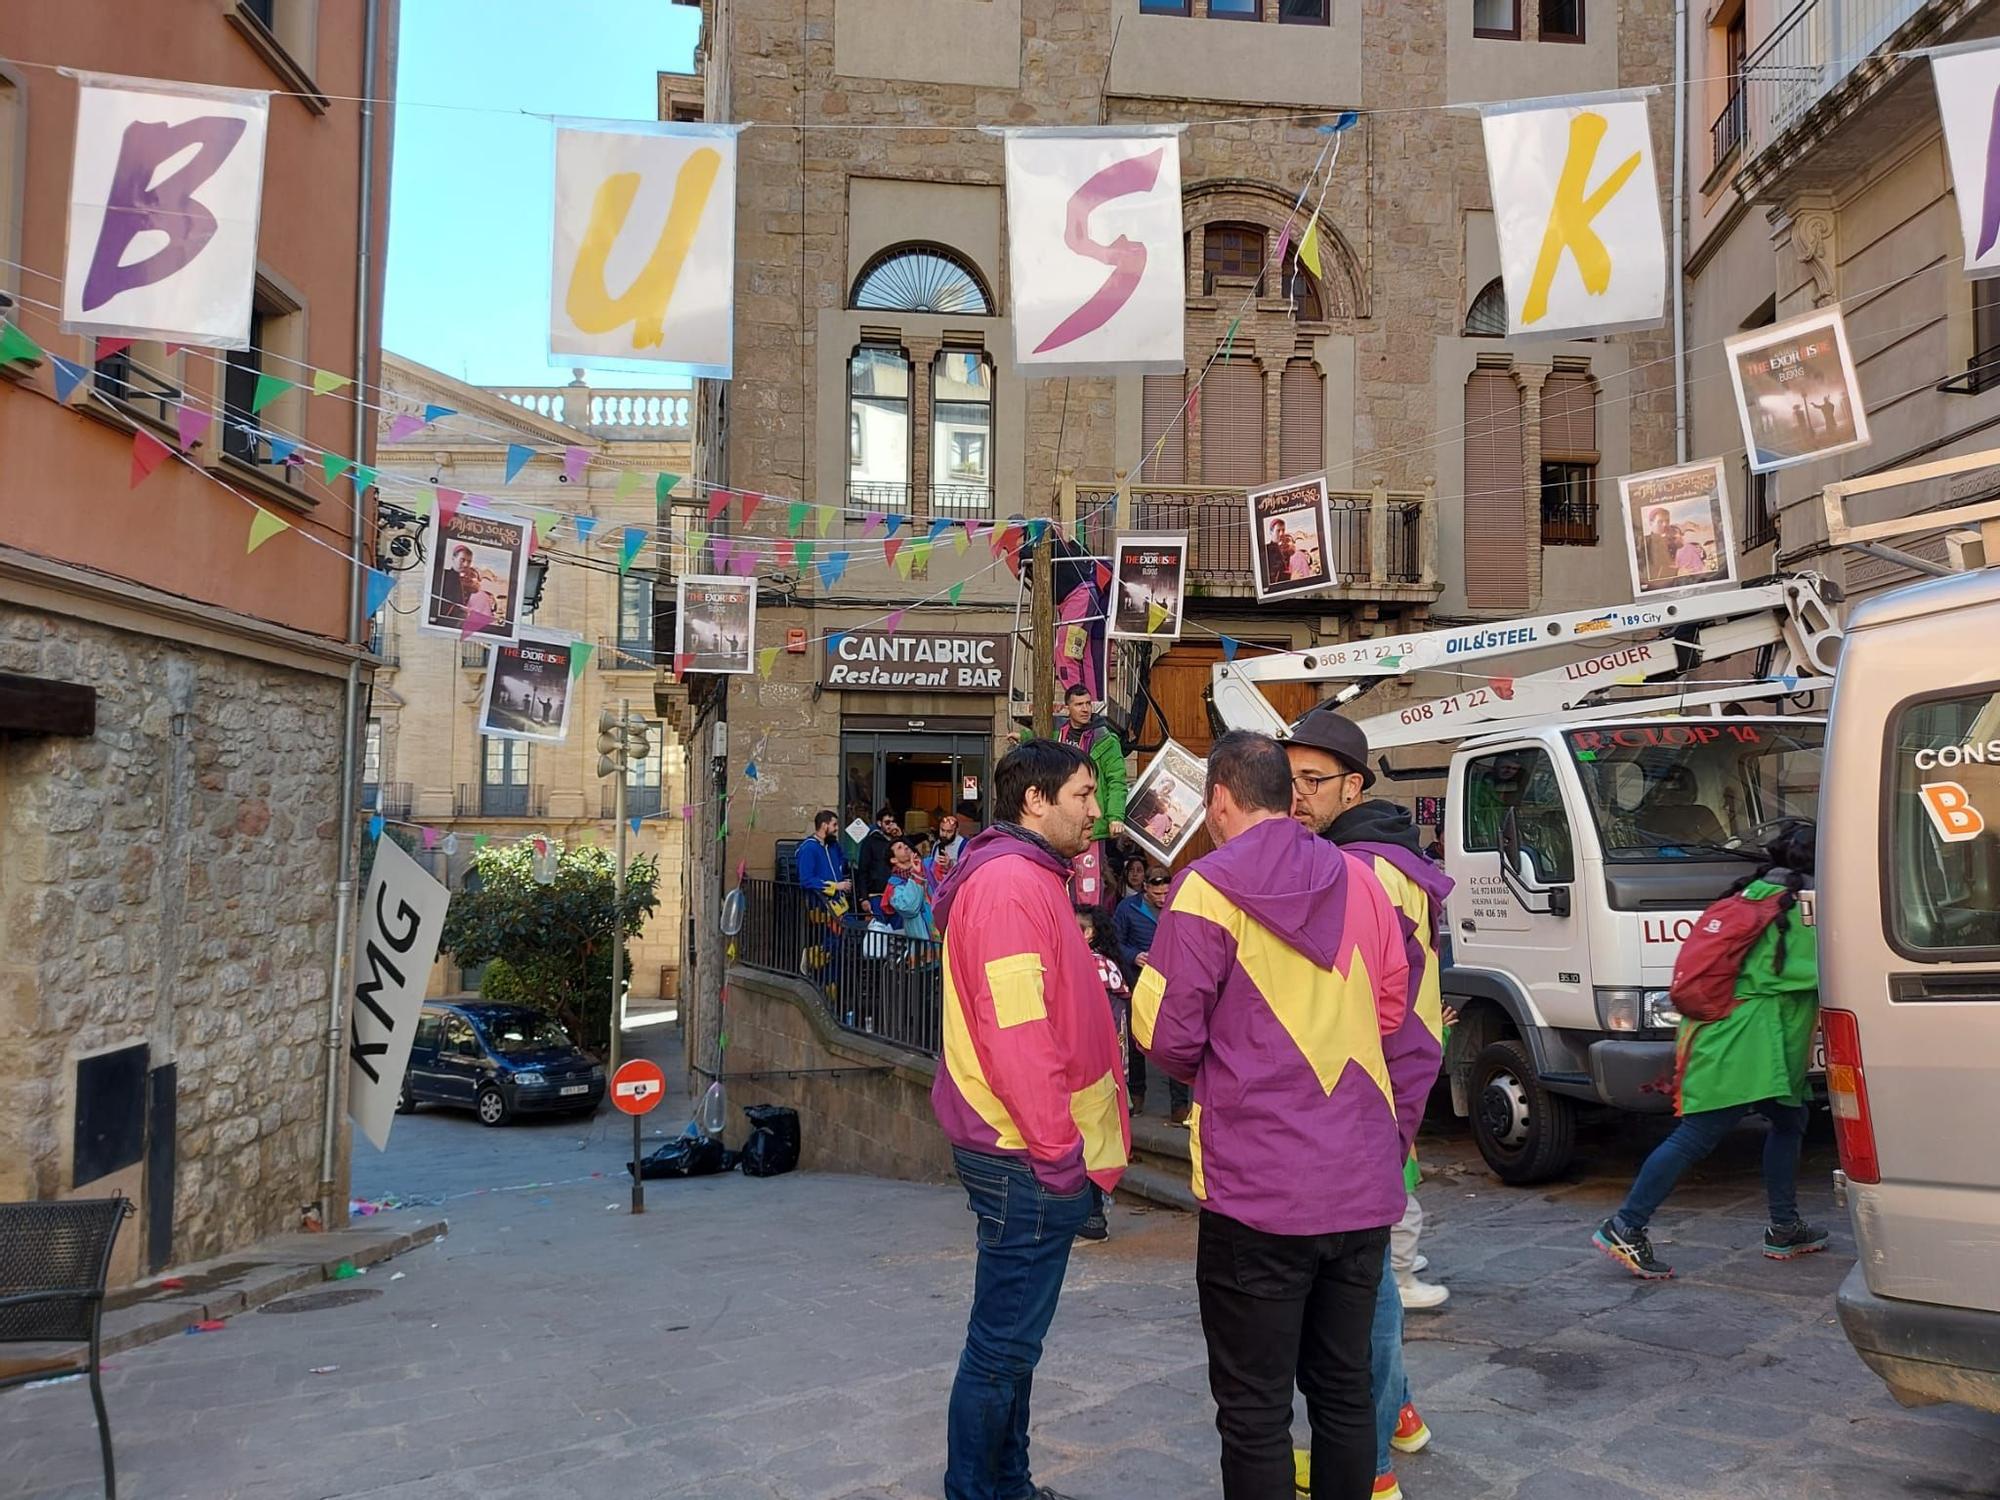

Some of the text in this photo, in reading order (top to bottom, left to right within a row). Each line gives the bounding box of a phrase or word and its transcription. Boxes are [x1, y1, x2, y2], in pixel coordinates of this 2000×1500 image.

[1621, 614, 1640, 626] 189
[1642, 612, 1662, 624] City
[838, 637, 996, 664] CANTABRIC
[1320, 642, 1414, 667] 608 21 22 13
[1565, 645, 1653, 681] LLOGUER
[829, 664, 1002, 688] Restaurant BAR
[1400, 704, 1434, 725] 608
[1440, 697, 1460, 715] 21
[1466, 690, 1489, 708] 22
[1727, 725, 1761, 744] 14
[1918, 781, 1985, 842] B
